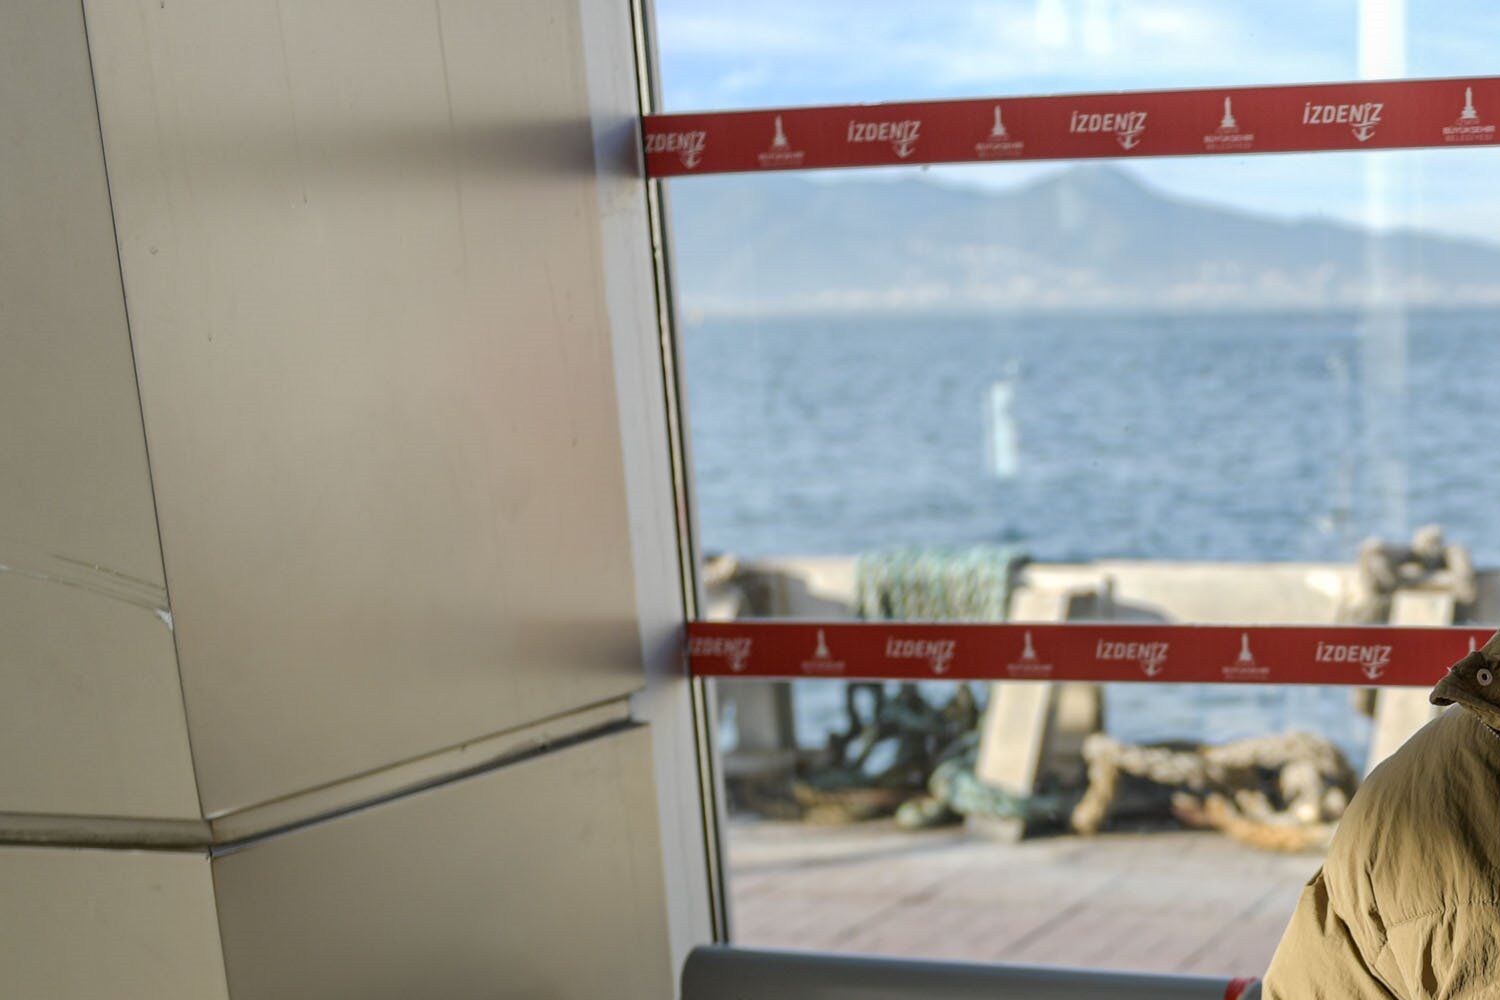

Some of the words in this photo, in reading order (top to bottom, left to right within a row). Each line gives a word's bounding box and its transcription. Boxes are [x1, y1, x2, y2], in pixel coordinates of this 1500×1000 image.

[1069, 110, 1147, 140] İZDENİZ
[1302, 101, 1385, 132] İZDENİZ
[645, 130, 706, 160] ZDENİZ
[847, 120, 921, 150] İZDENİZ
[1096, 638, 1169, 667] İZDENİZ
[1315, 641, 1392, 670] İZDENİZ
